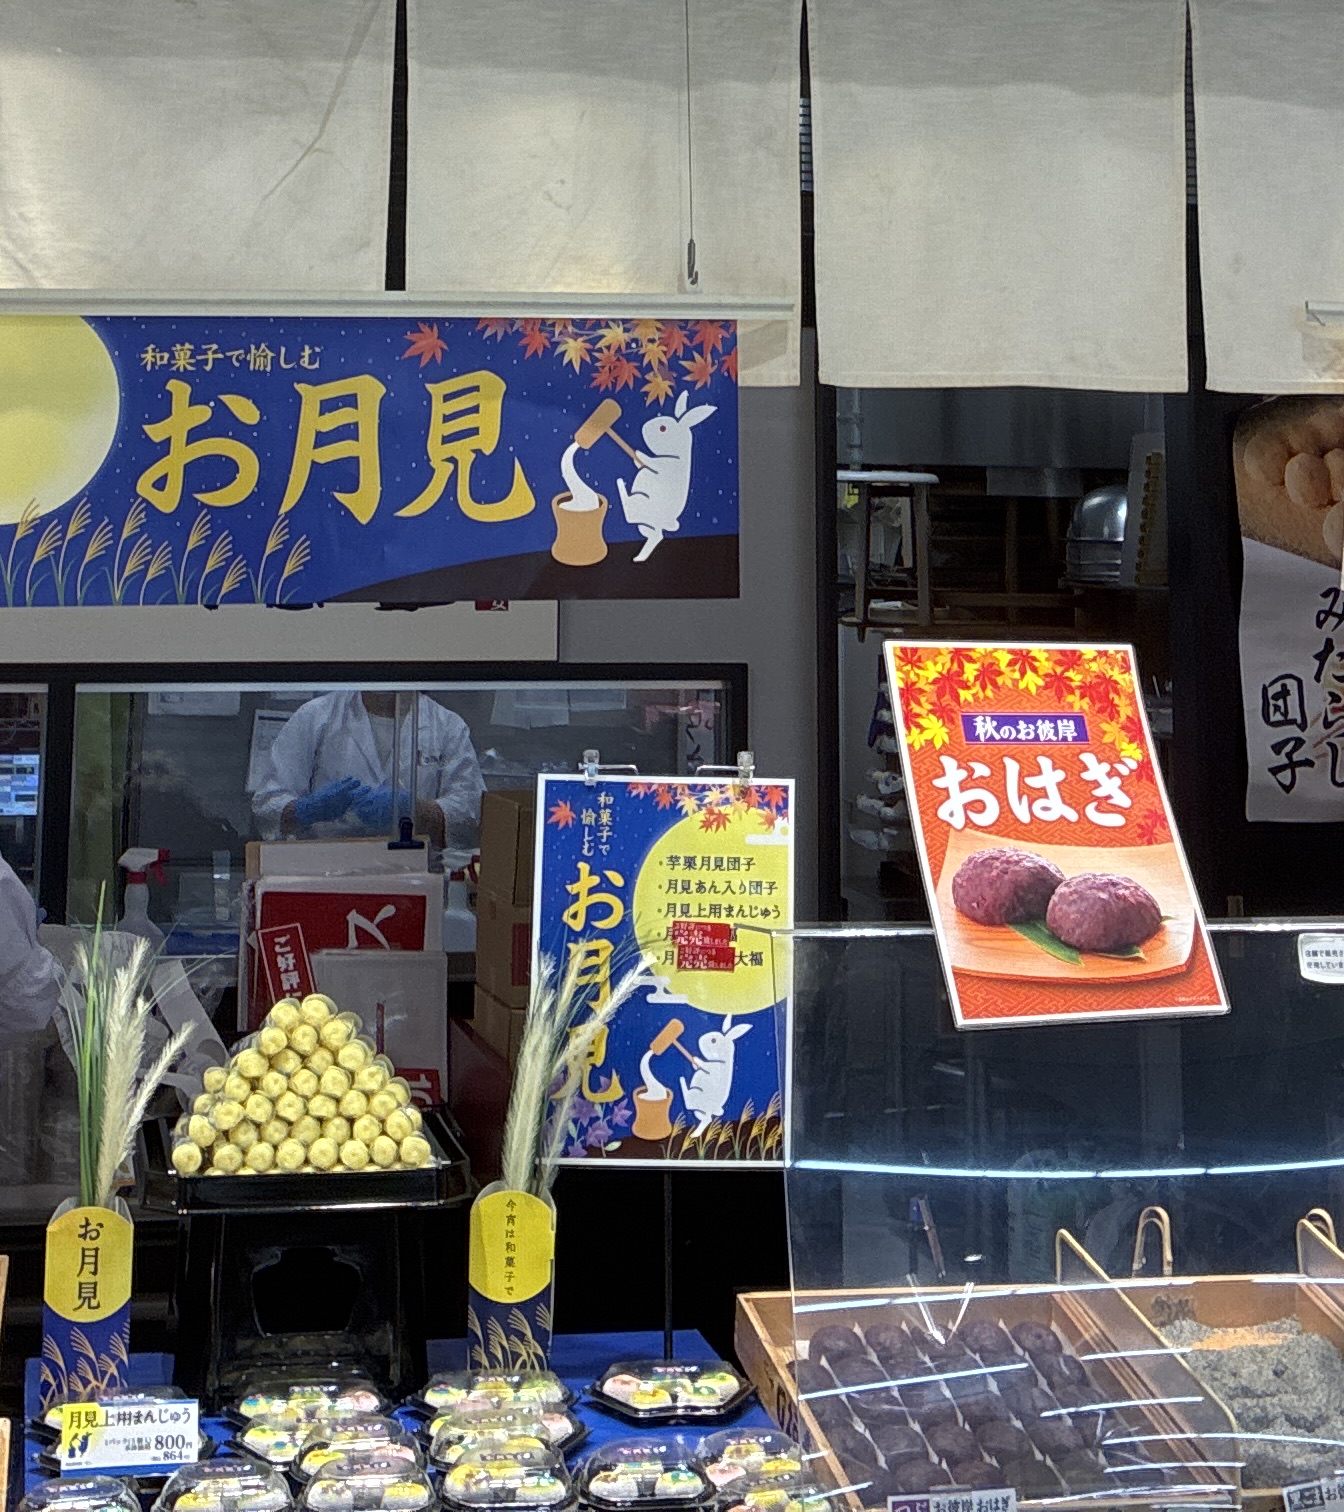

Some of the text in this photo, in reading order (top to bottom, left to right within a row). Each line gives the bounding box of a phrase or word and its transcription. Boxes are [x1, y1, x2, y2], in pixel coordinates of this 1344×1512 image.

[141, 342, 322, 371] 和菓子で愉しむ
[136, 370, 537, 524] お月見
[972, 715, 1079, 743] 秋のお彼岸
[1260, 674, 1316, 793] 団子
[931, 751, 1139, 829] おはぎ
[665, 879, 778, 896] 月見あん入り団子
[666, 855, 756, 872] 芋栗月見団子
[664, 902, 781, 919] 月見上用まんじゅう
[552, 861, 626, 1103] お月見
[73, 1216, 105, 1311] お月見
[503, 1198, 516, 1296] 今宵は和菓子で
[68, 1407, 192, 1429] 月見上用まんじゅう
